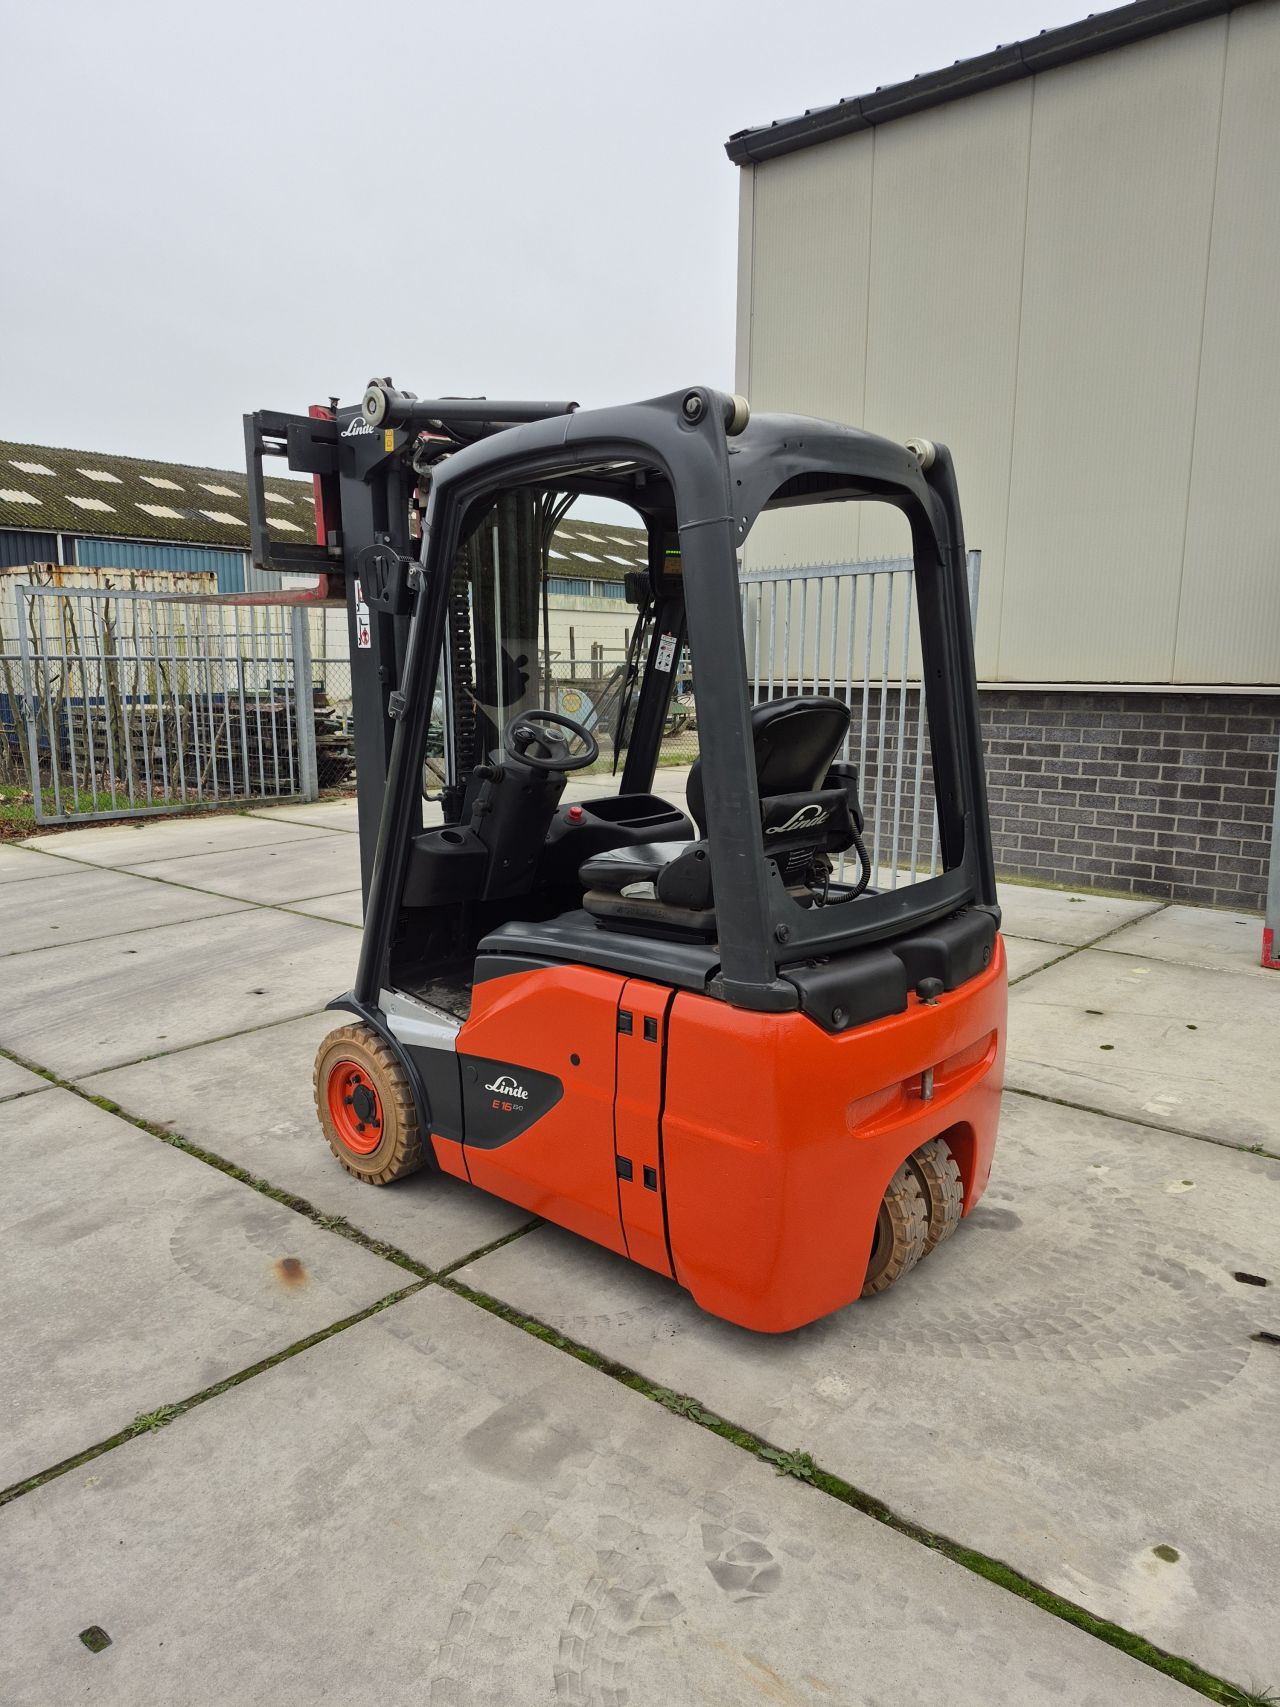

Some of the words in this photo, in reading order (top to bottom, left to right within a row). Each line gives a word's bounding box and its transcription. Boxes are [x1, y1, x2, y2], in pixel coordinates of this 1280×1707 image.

[341, 417, 374, 437] Linde
[765, 804, 830, 834] Linde
[485, 1076, 528, 1099] Linde
